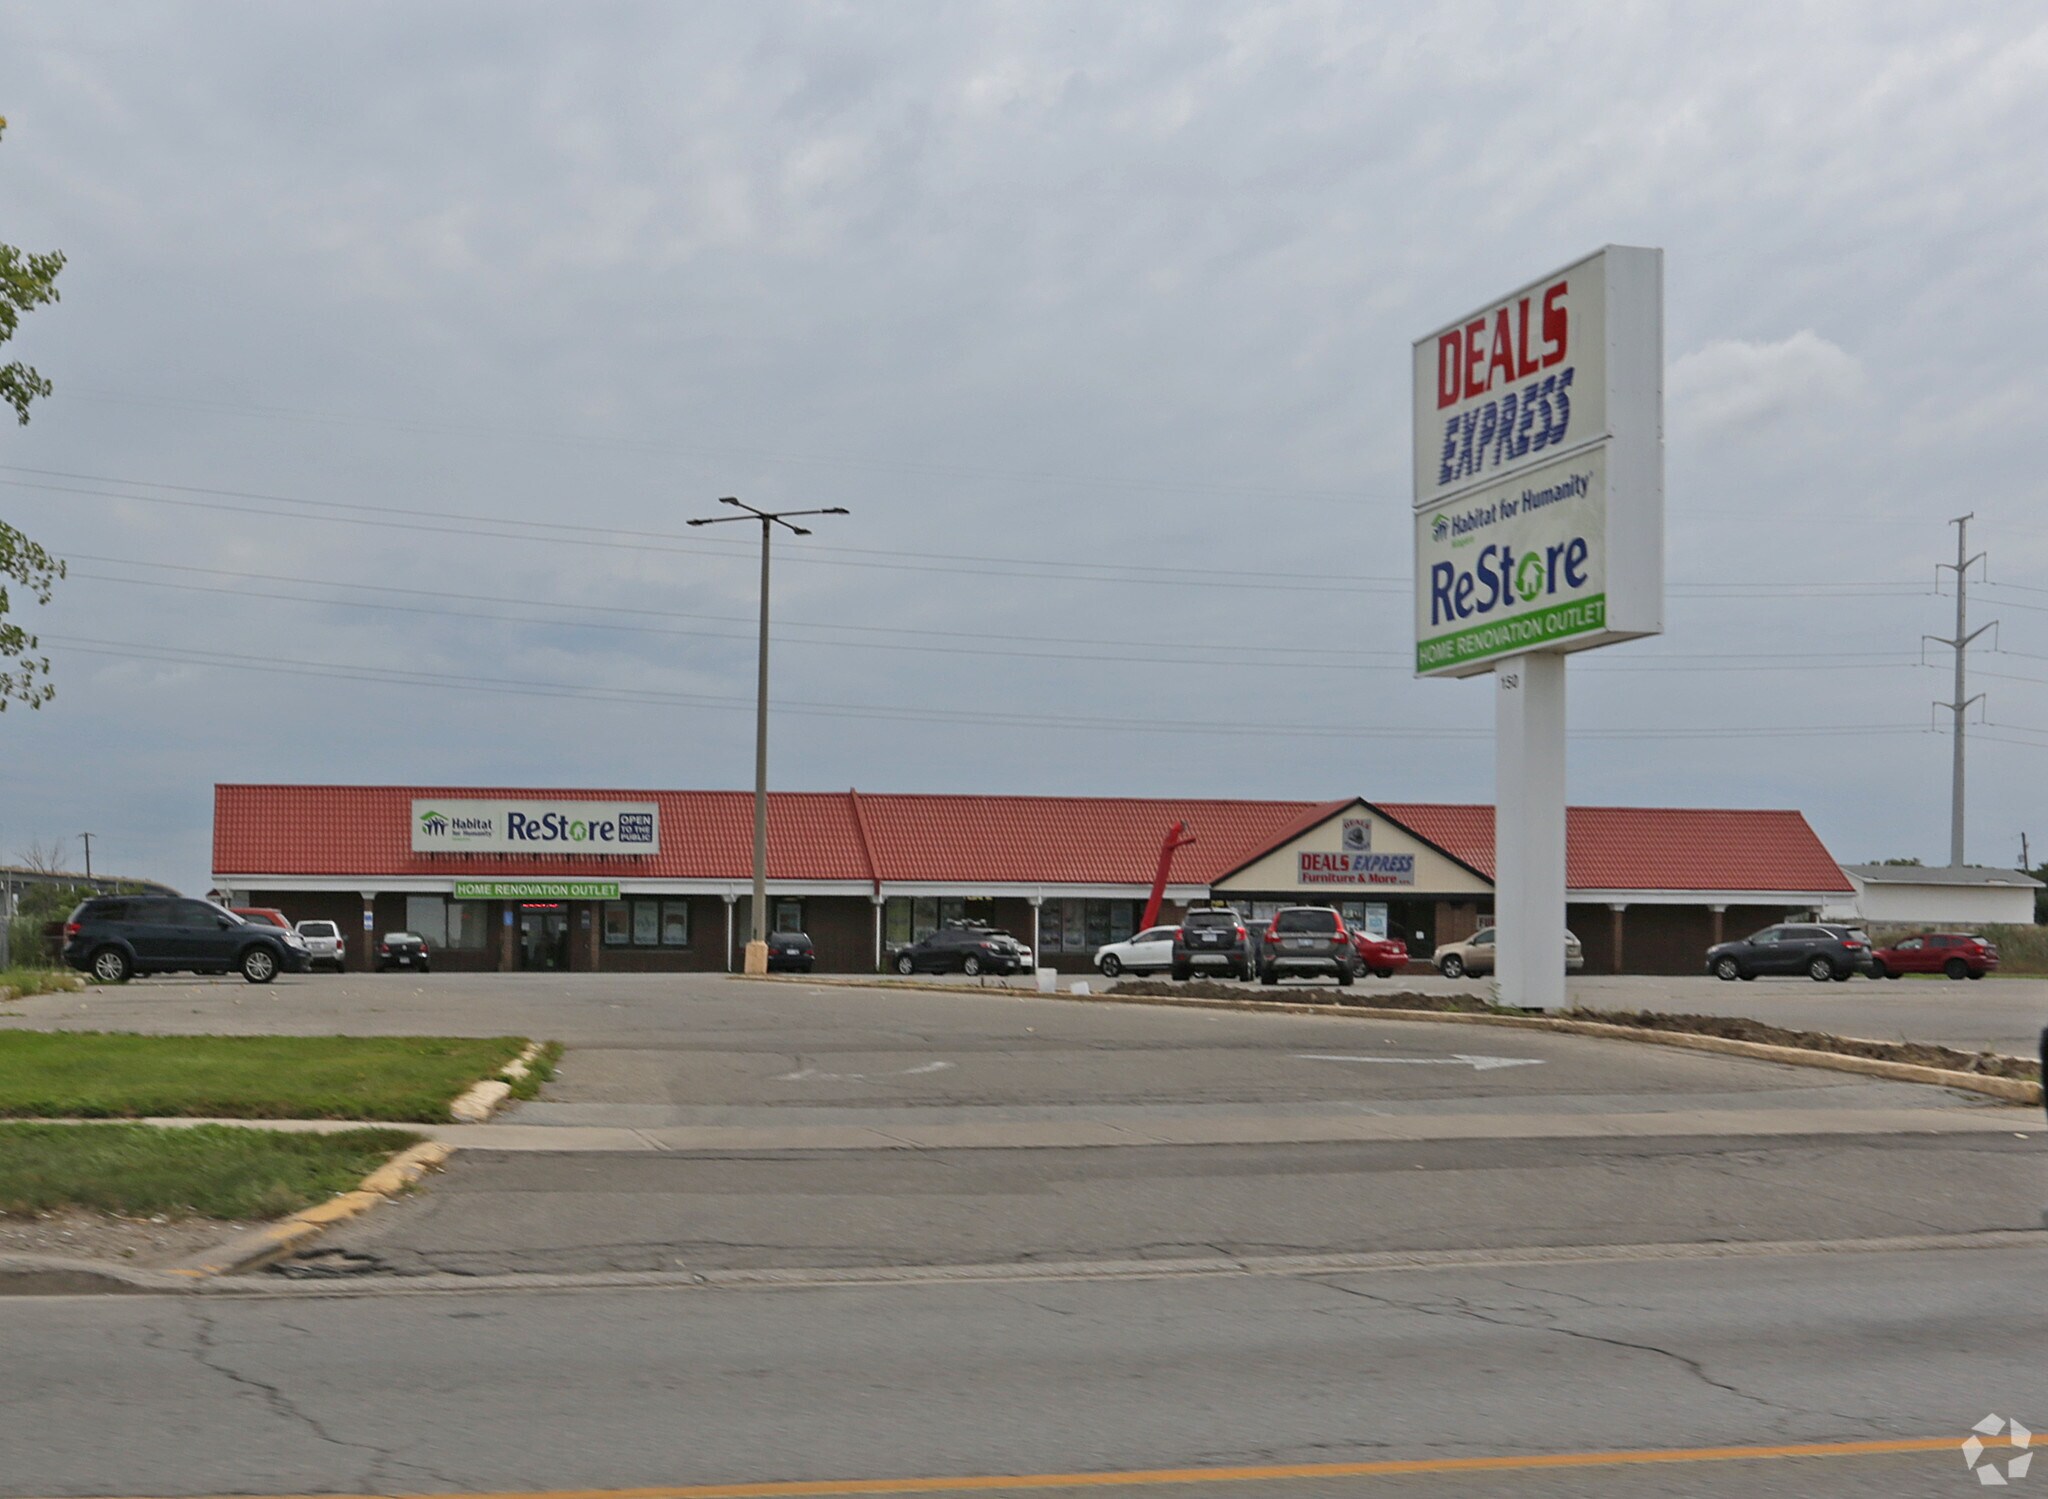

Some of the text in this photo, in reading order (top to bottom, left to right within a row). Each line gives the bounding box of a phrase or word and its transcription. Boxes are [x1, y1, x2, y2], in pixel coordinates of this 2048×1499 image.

[1437, 280, 1569, 411] DEALS
[1438, 366, 1575, 486] EXPRESS
[1451, 473, 1589, 537] Habitat for Humanity
[1430, 536, 1589, 626] ReStore
[1418, 601, 1605, 665] HOME RENOVATION OUTLET
[452, 817, 493, 830] Habitat
[507, 811, 615, 842] ReStore
[620, 815, 651, 825] OPEN
[620, 825, 651, 834] TO THE
[620, 833, 651, 842] PUBLIC
[1301, 853, 1414, 873] DEALS EXPRESS
[1302, 873, 1356, 884] Furniture
[1357, 873, 1366, 884] &
[1369, 873, 1398, 885] More
[457, 884, 616, 896] HOME RENOVATION OUTLET
